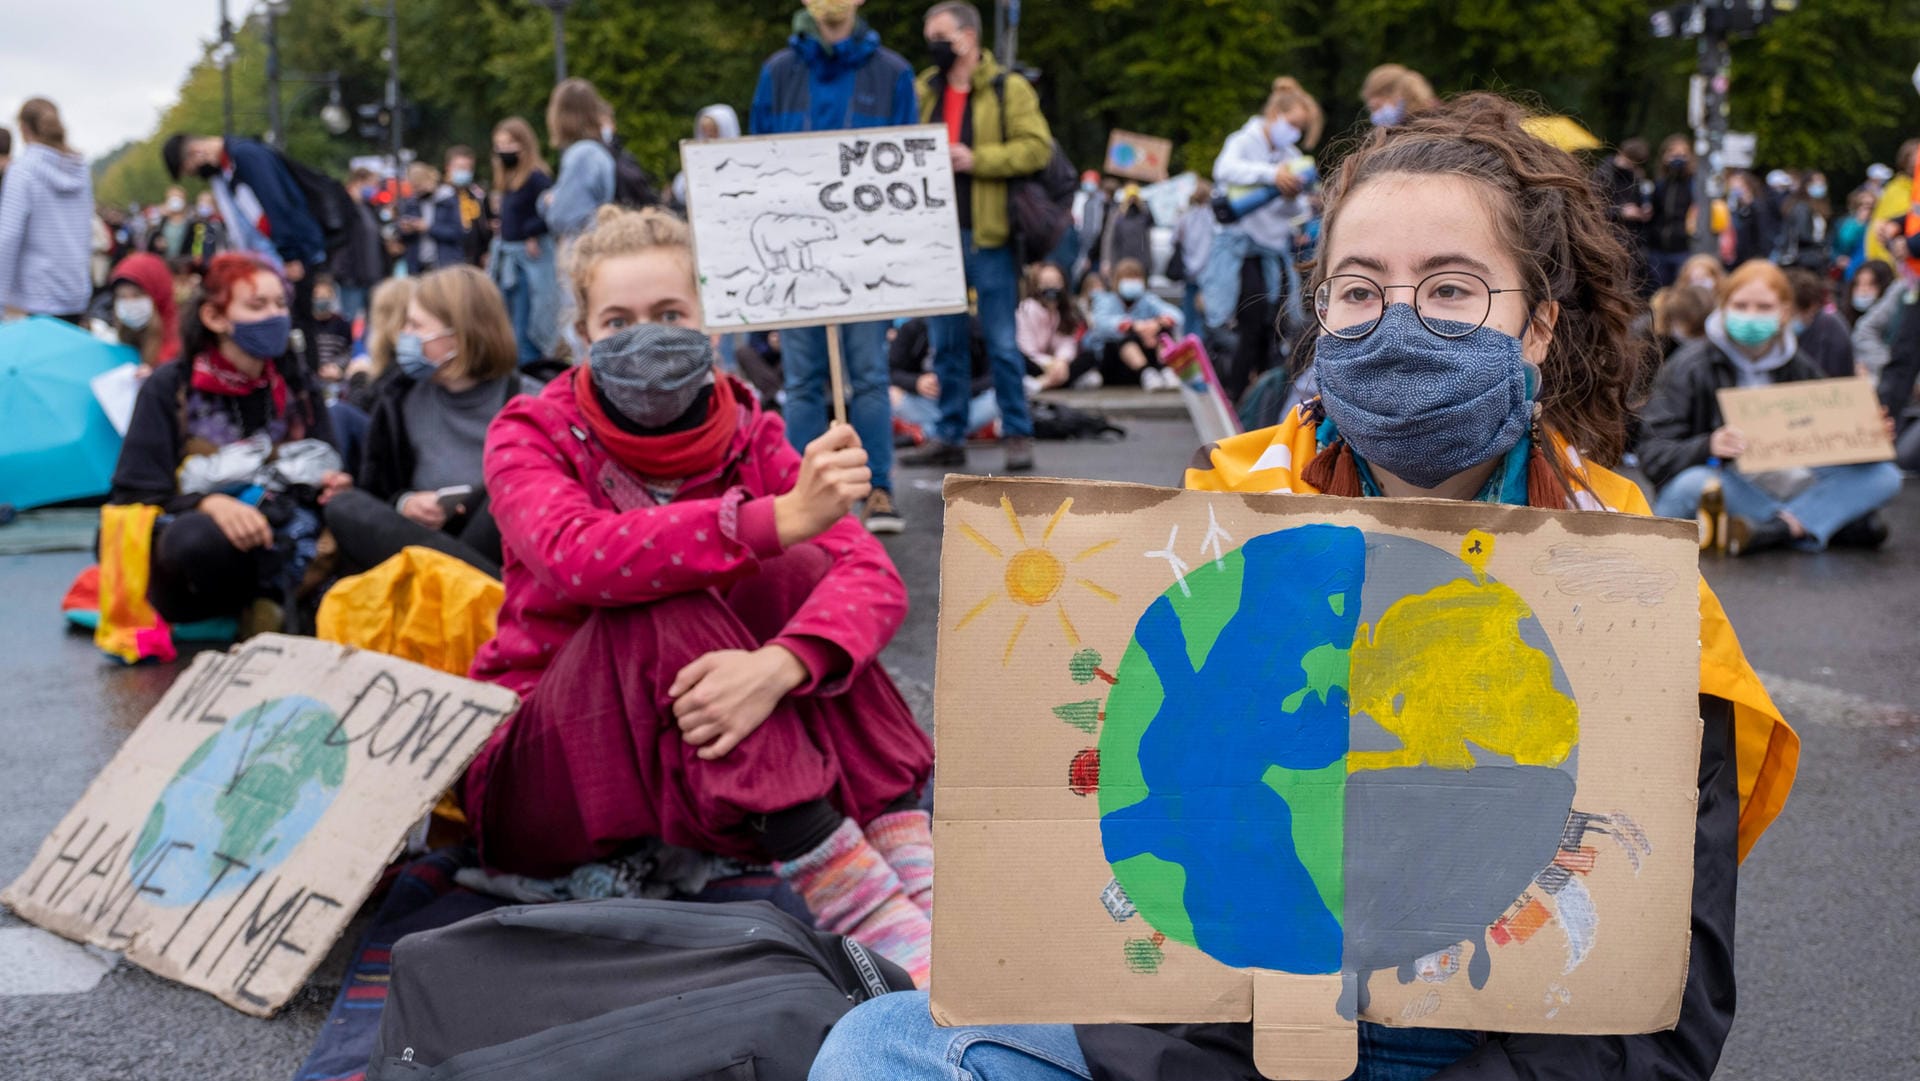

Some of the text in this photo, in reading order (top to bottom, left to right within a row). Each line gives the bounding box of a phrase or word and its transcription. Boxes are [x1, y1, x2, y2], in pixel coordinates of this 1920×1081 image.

[838, 137, 937, 177] NOT
[818, 176, 946, 213] COOL
[166, 645, 503, 780] WE DONT
[28, 817, 343, 1007] HAVE TIME
[847, 940, 876, 982] ORTLIEB
